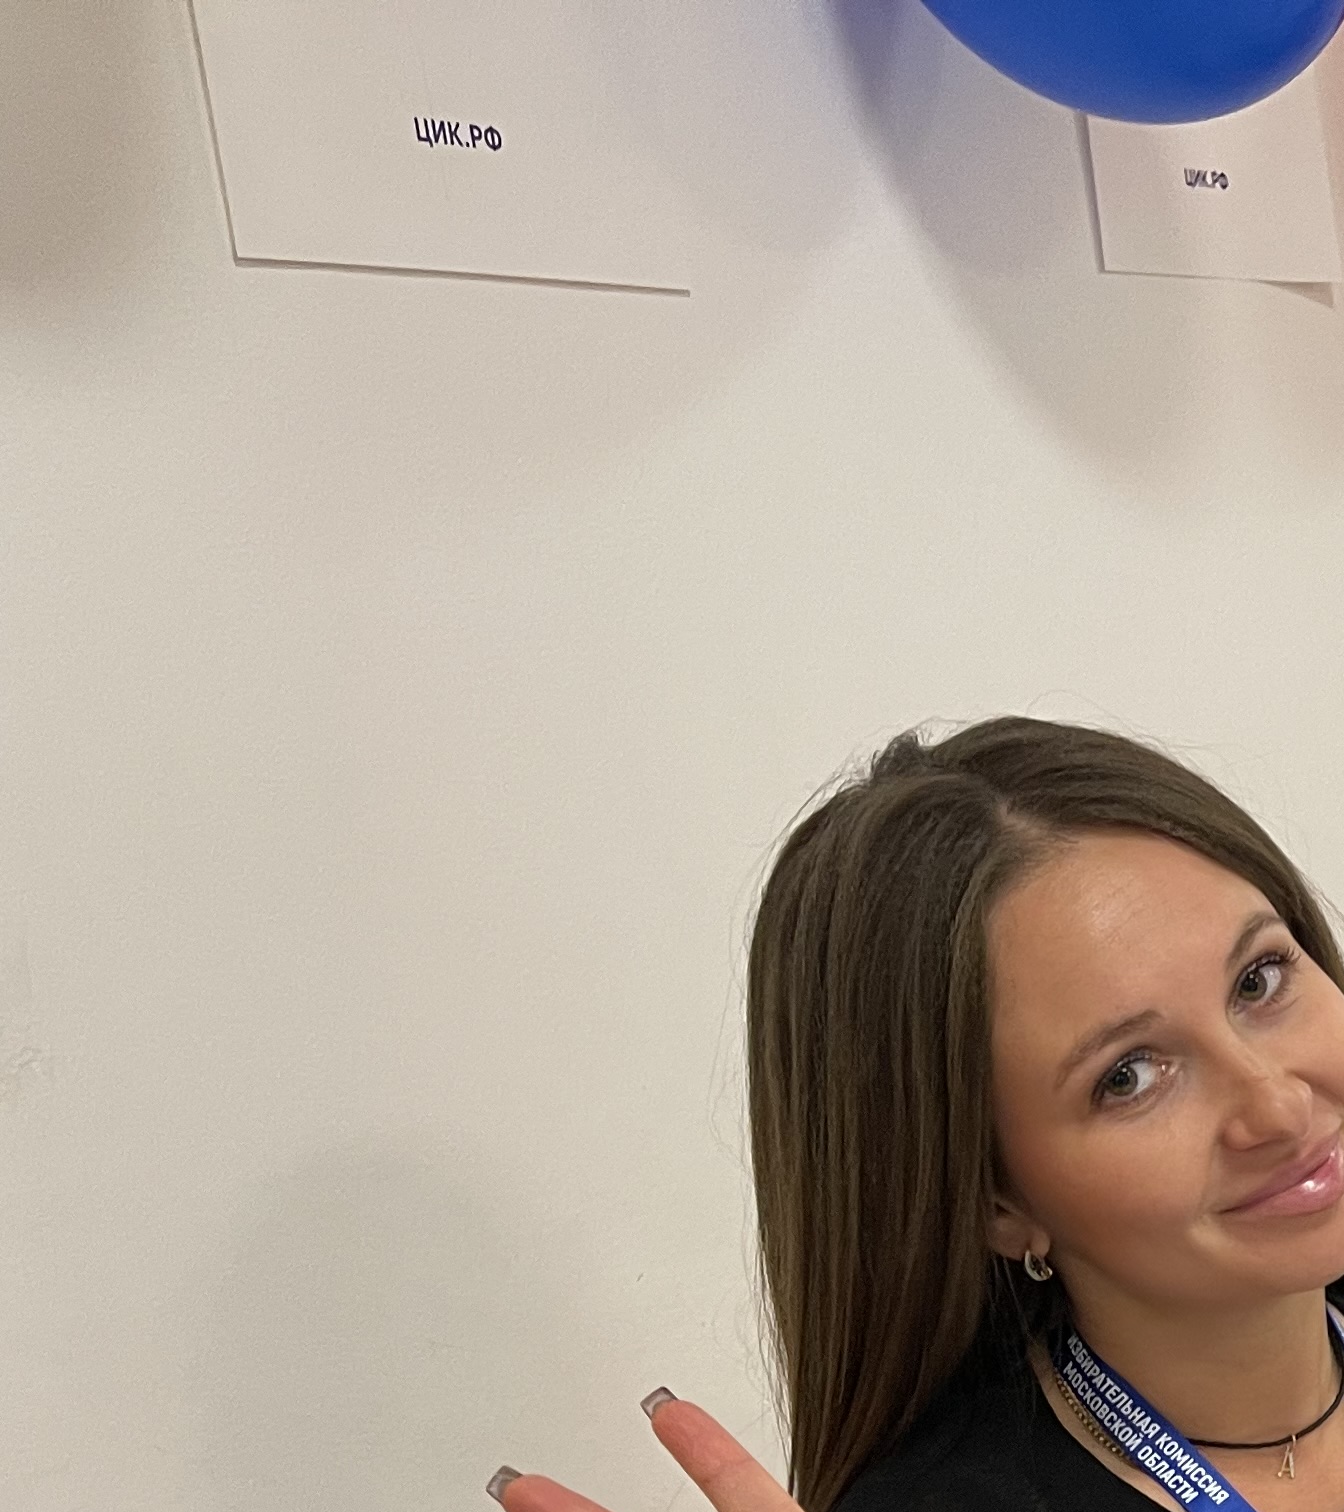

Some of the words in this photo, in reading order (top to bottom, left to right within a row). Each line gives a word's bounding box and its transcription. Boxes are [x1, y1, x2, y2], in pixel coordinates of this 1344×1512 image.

[413, 116, 503, 152] ЦИК.РФ
[1062, 1360, 1145, 1452] МОСКОВСКОЙ
[1137, 1445, 1199, 1504] ОБЛАСТИ
[1067, 1334, 1162, 1440] ИЗБИРАТЕЛЬНАЯ
[1154, 1431, 1230, 1505] КОМИССИЯ
